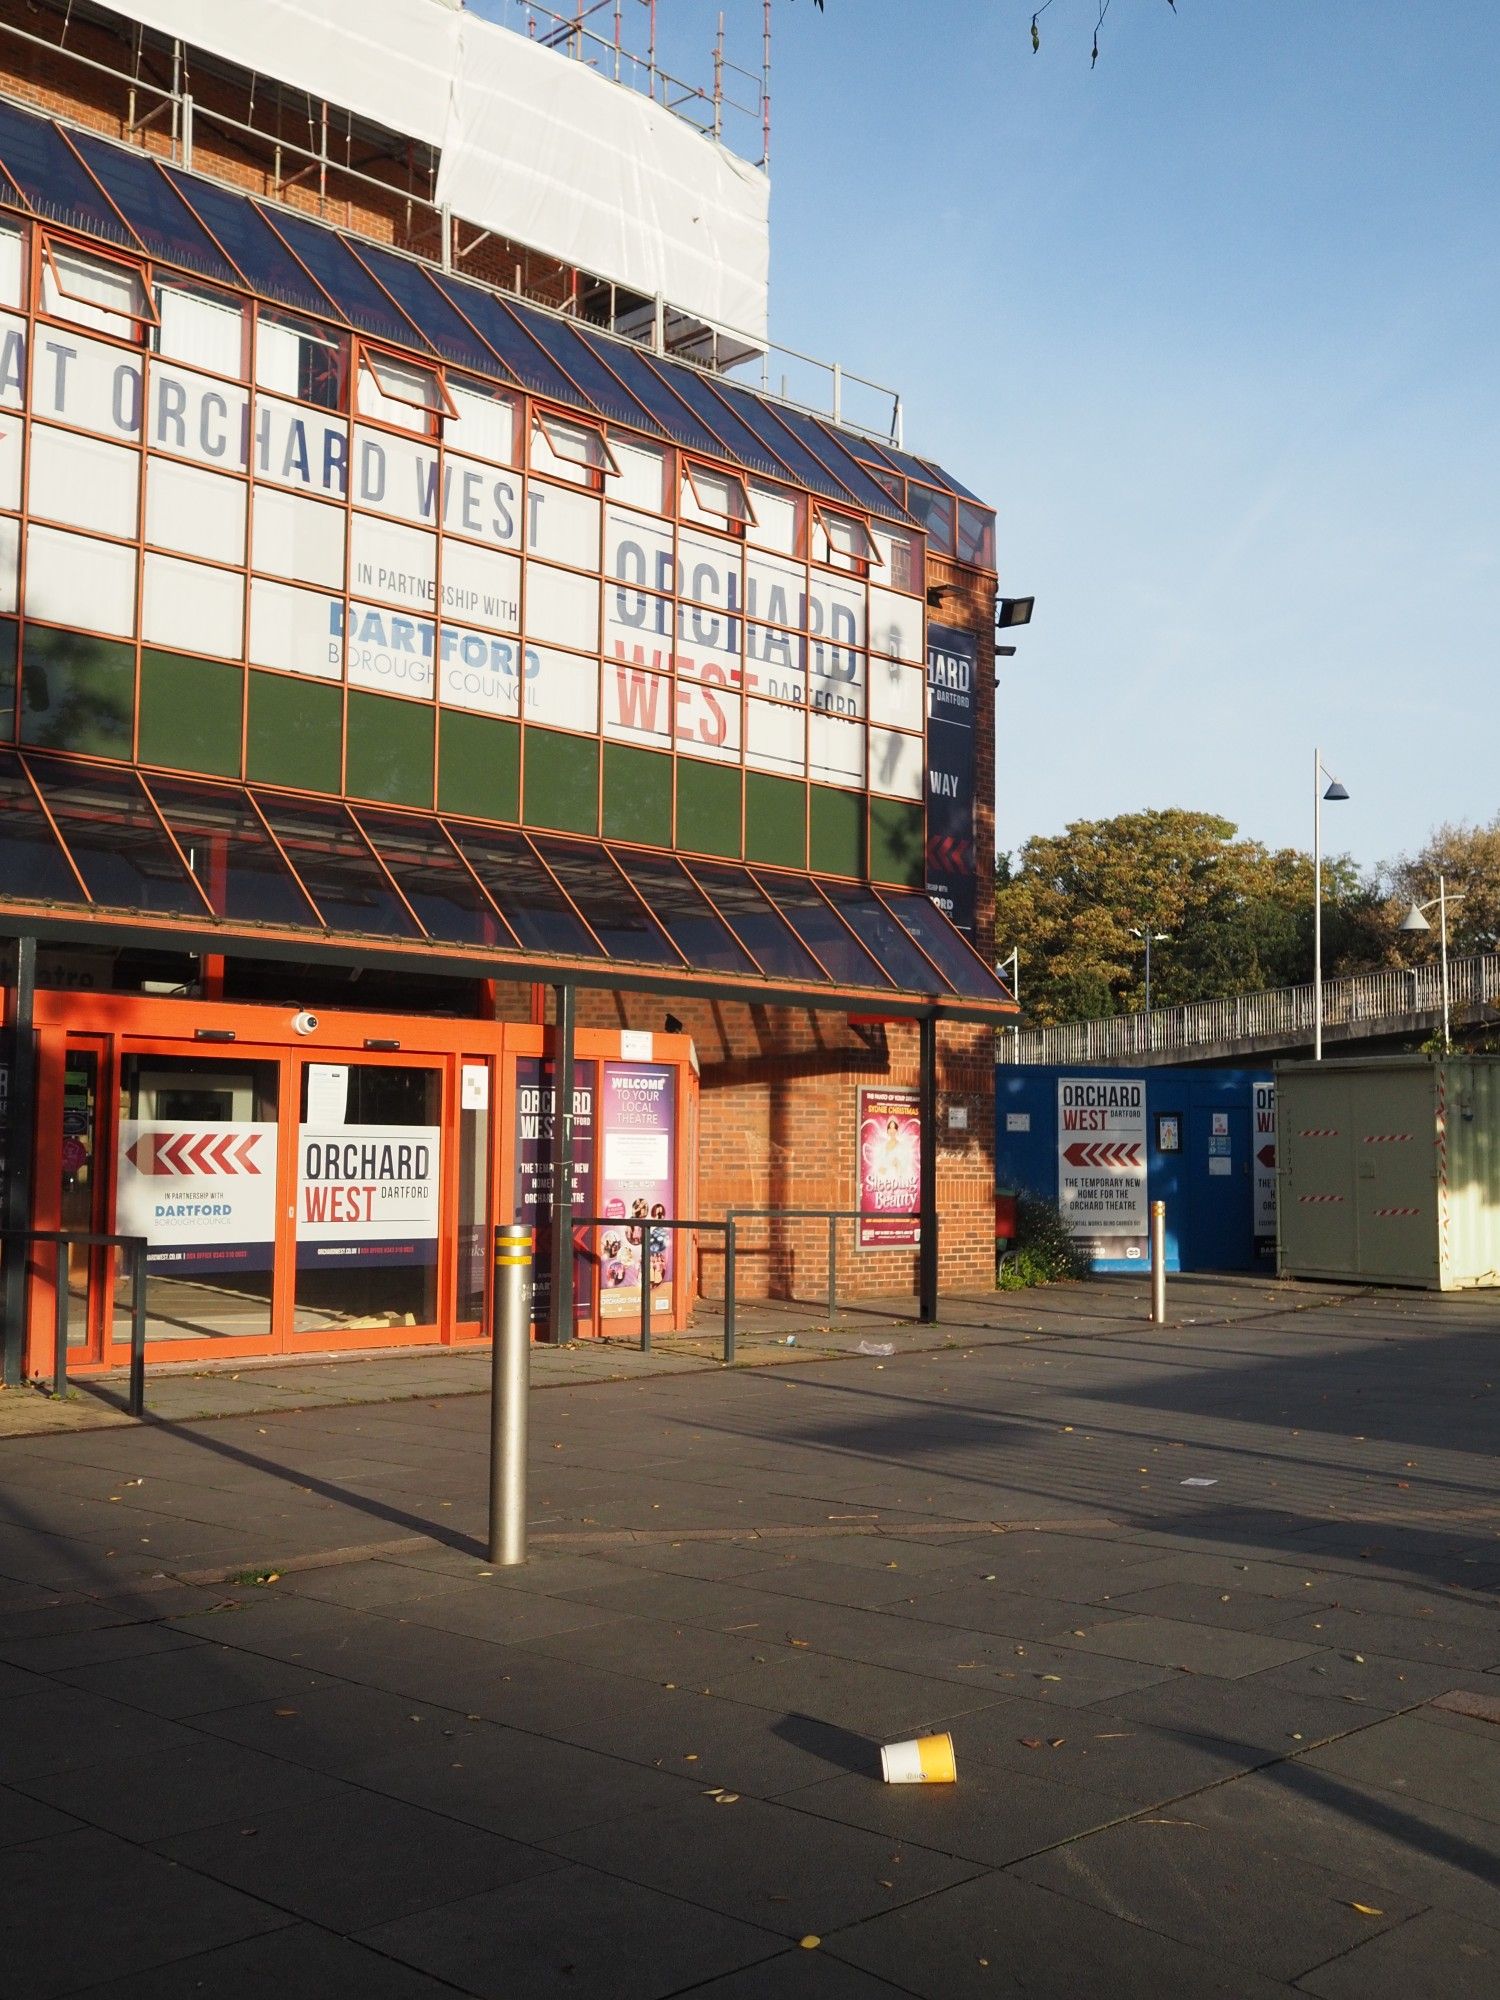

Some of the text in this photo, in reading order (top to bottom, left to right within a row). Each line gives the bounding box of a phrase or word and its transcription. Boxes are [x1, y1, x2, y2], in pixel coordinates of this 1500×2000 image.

[0, 330, 545, 548] AT ORCHARD WEST
[357, 562, 518, 622] IN PARTNERSHIP WITH
[616, 540, 856, 683] ORCHARD
[329, 601, 541, 680] DARTFORD
[328, 642, 539, 707] BOROUGH COUNCIL
[926, 651, 970, 692] HARD
[614, 639, 759, 751] WEST
[768, 678, 857, 725] DARFORD
[936, 690, 970, 709] DARTFORD
[930, 770, 959, 798] WAY
[611, 1077, 665, 1091] WELCOME
[521, 1089, 591, 1115] ORCRD
[616, 1089, 660, 1102] TO YOUR
[1062, 1085, 1141, 1107] ORCHARD
[622, 1101, 654, 1113] LOCAL
[520, 1115, 556, 1140] WES
[616, 1113, 658, 1125] THEATRE
[1062, 1109, 1141, 1131] WEST DARTFORD
[306, 1143, 430, 1180] ORCHARD
[520, 1163, 534, 1174] THE
[574, 1163, 589, 1174] NEW
[865, 1174, 918, 1194] Sleeping
[1064, 1177, 1141, 1188] THE TEMPORARY NEW
[1258, 1178, 1271, 1188] THE
[164, 1192, 224, 1200] IN PARTNERSHIP WITH
[305, 1186, 429, 1222] WEST DARTFORD
[873, 1191, 918, 1213] Beauty
[1077, 1189, 1129, 1199] HOME FOR THE
[155, 1204, 232, 1217] DARTFORD
[1069, 1201, 1137, 1211] ORCHARD THEATRE
[154, 1217, 232, 1227] BOROUGH COUNCIL
